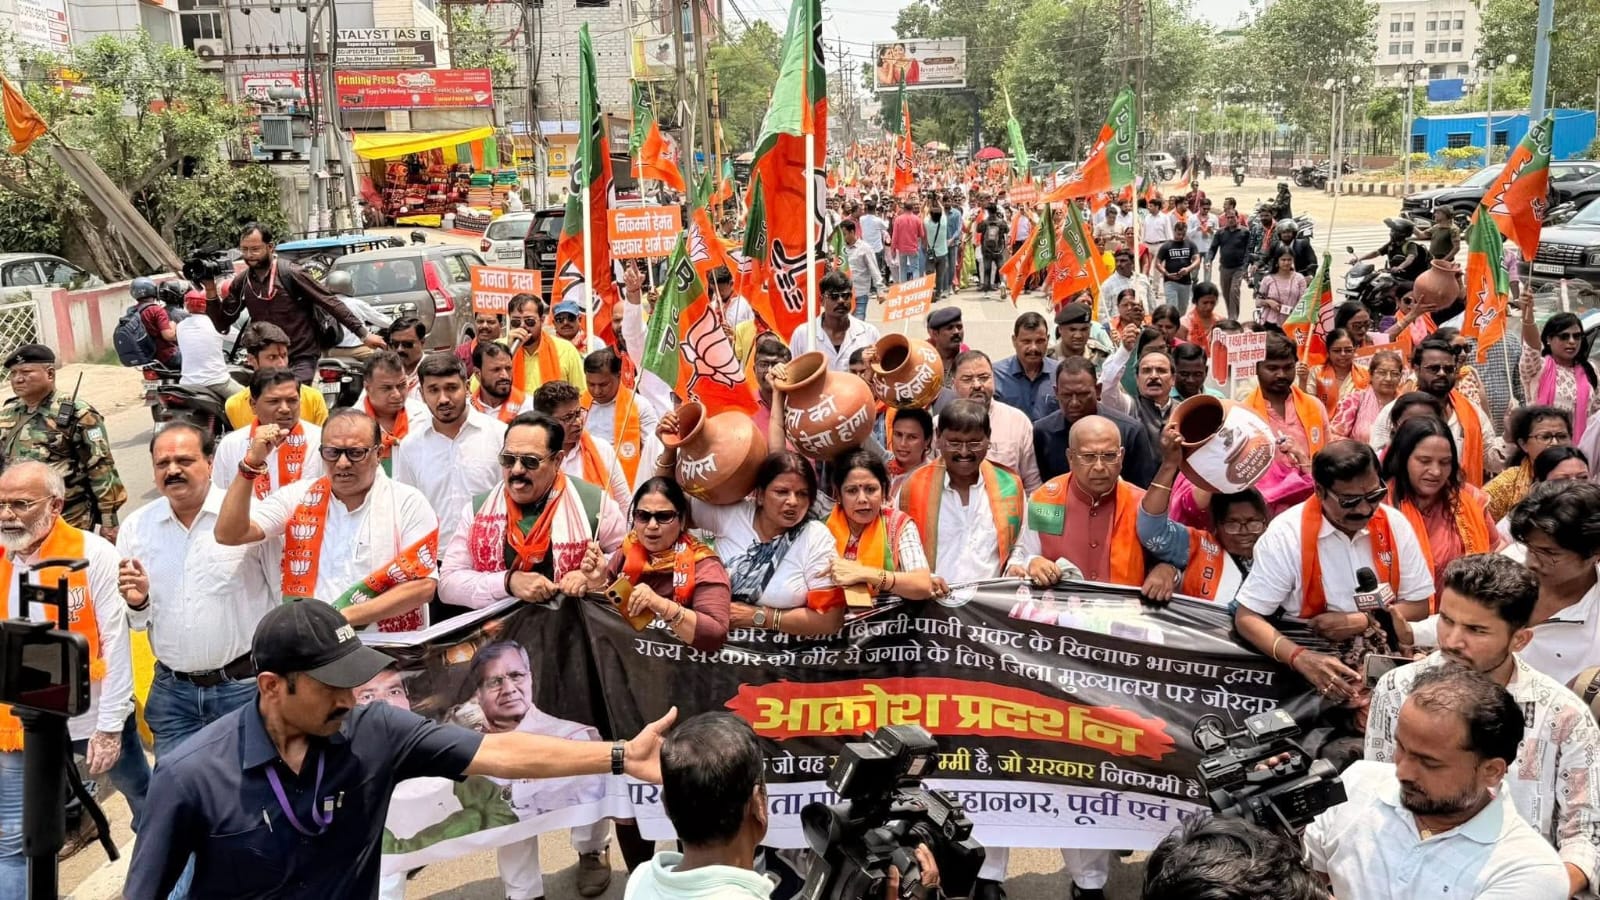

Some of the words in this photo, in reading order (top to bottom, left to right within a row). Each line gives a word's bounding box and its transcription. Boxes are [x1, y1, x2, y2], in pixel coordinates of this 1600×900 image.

[335, 29, 390, 39] TALYST
[394, 29, 417, 39] IAS
[338, 75, 372, 86] Printing
[372, 74, 396, 84] Press
[615, 212, 651, 234] निकम्मी
[611, 238, 643, 255] सरकार
[477, 269, 509, 288] जनता
[510, 271, 534, 290] त्रस्त
[807, 393, 838, 422] को
[835, 404, 868, 442] होगा
[967, 622, 1024, 648] संकट
[1029, 629, 1054, 652] के
[1058, 636, 1142, 667] खिलाफ
[1146, 655, 1220, 679] भाजपा
[1223, 667, 1275, 686] द्वारा
[634, 638, 683, 661] राज्य
[801, 645, 840, 666] नींद
[843, 644, 860, 664] से
[865, 639, 923, 663] जगाने
[927, 640, 950, 662] के
[955, 644, 995, 670] लिए
[1000, 654, 1054, 683] जिला
[1058, 668, 1160, 699] मुख्यालय
[1164, 684, 1197, 704] पर
[1201, 685, 1279, 714] जोरदार
[753, 684, 948, 732] आक्रोश
[948, 695, 1144, 752] प्रदर्शन
[771, 750, 796, 774] जो
[798, 755, 826, 774] वह
[974, 747, 993, 775] है,
[997, 750, 1023, 773] जो
[1026, 757, 1096, 779] सरकार
[1100, 761, 1182, 795] निकम्मी
[955, 791, 1060, 818] हानगर,
[1067, 791, 1124, 825] पूर्वी
[1127, 799, 1170, 821] एवं
